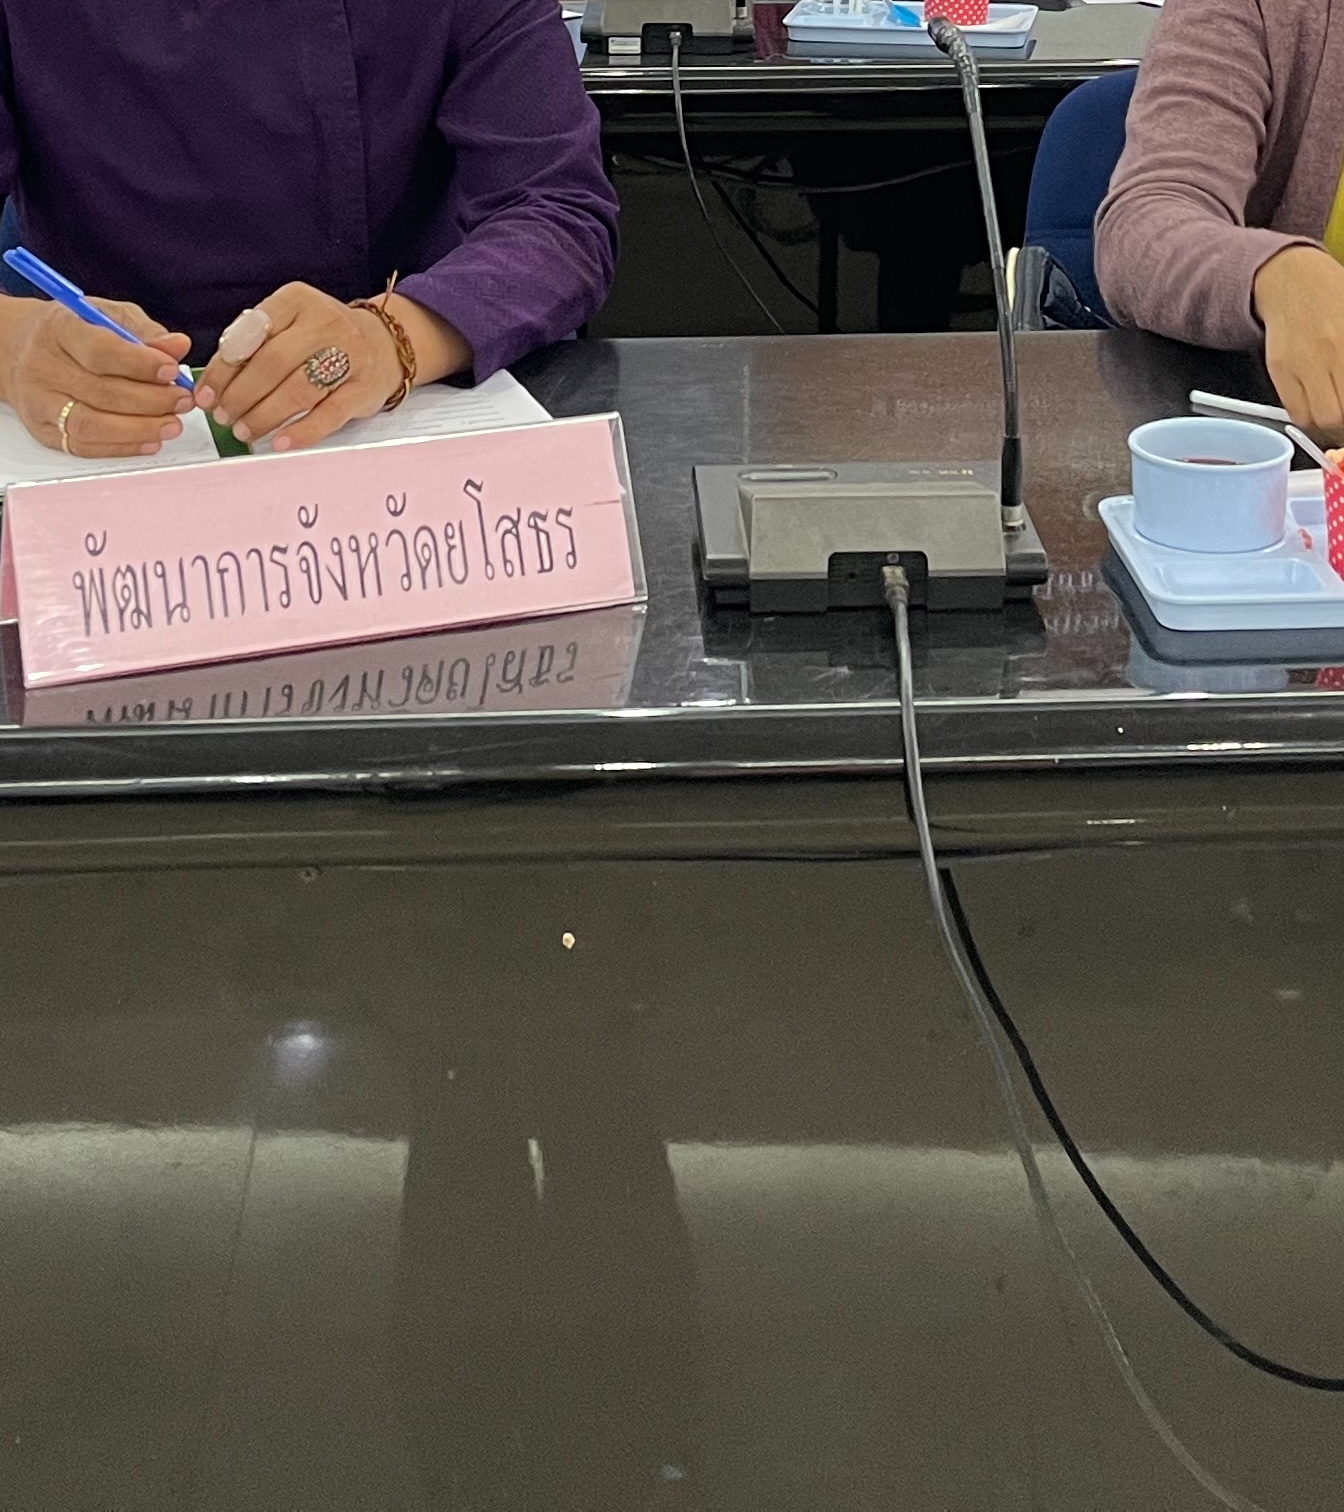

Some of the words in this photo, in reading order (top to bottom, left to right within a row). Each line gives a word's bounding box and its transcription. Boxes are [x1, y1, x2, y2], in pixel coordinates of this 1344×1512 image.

[71, 478, 579, 637] พัฒนาการจังหวัดยโสธร
